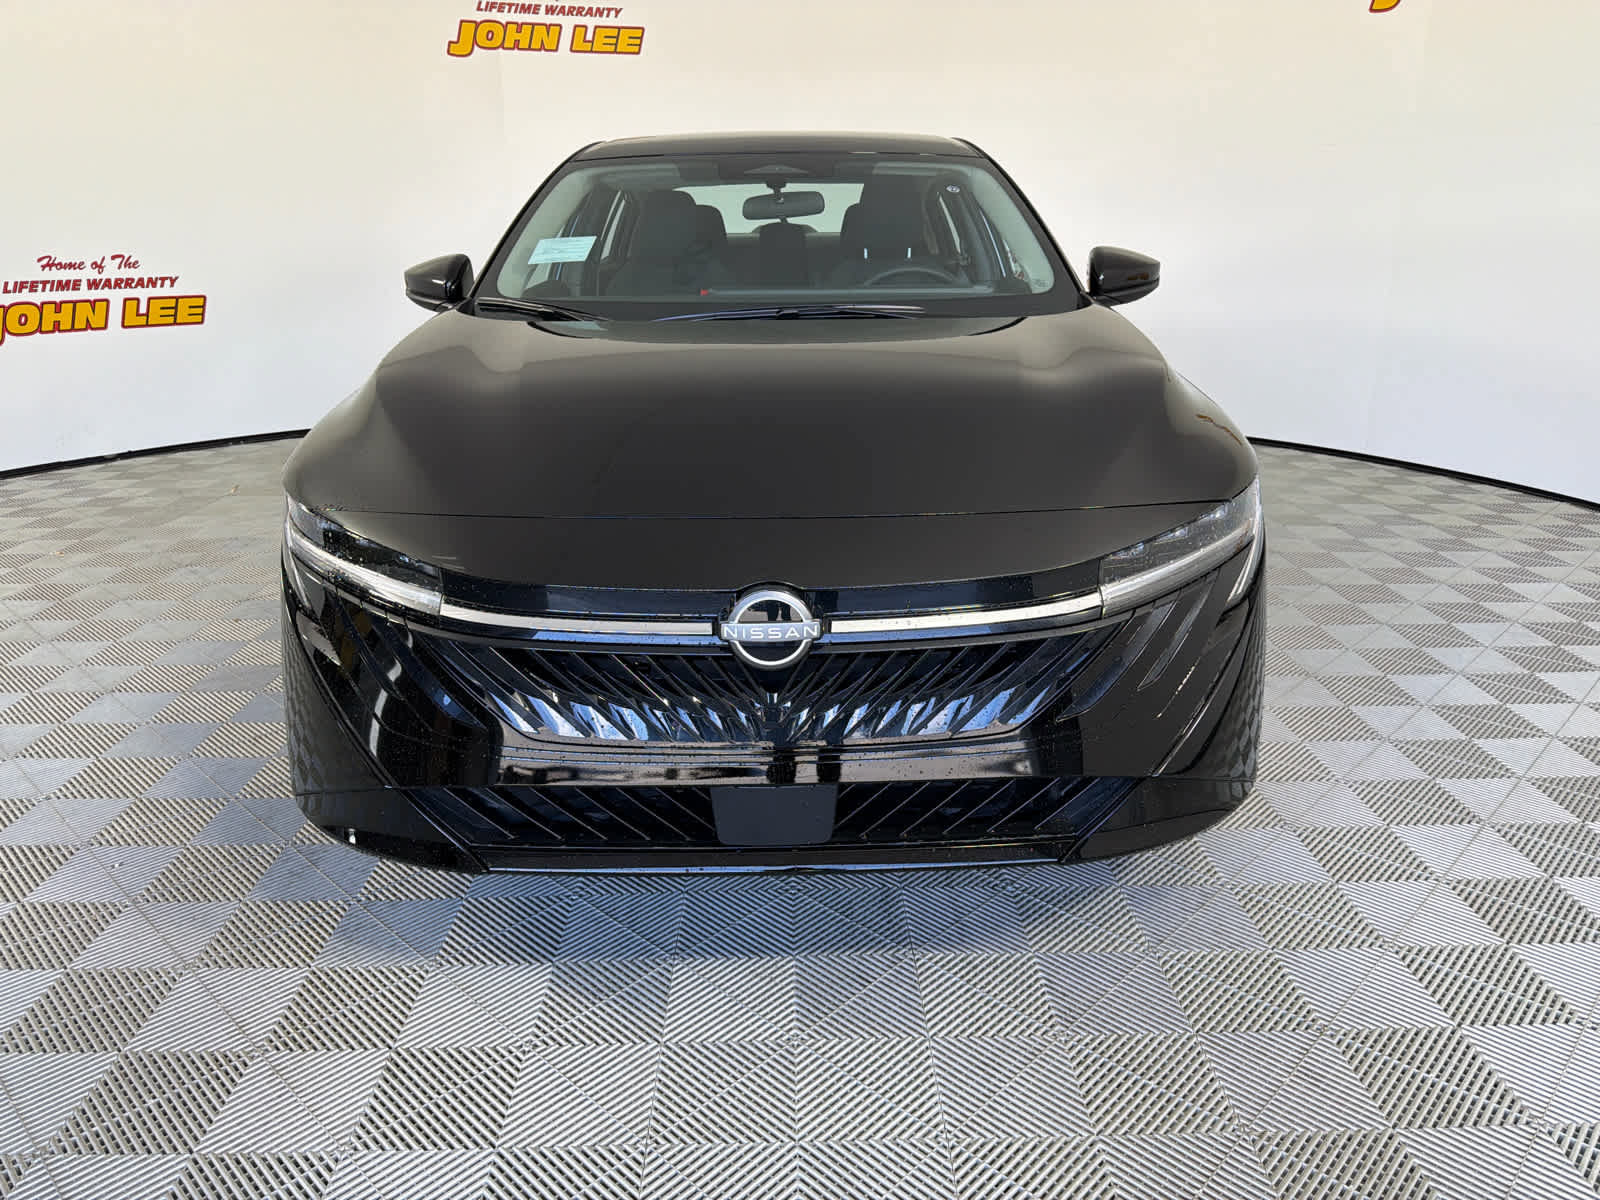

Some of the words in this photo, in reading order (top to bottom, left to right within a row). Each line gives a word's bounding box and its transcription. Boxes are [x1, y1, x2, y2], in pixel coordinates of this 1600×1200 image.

[476, 1, 541, 15] LIFETIME
[545, 4, 623, 18] WARRANTY
[447, 19, 562, 57] JOHN
[570, 24, 645, 55] LEE
[37, 255, 86, 272] Home
[91, 256, 106, 274] of
[110, 254, 140, 270] The
[2, 279, 82, 294] LIFETIME
[87, 276, 179, 291] WARRANTY
[0, 298, 110, 346] OHN
[121, 295, 206, 329] LEE
[724, 624, 818, 640] NISSAN
